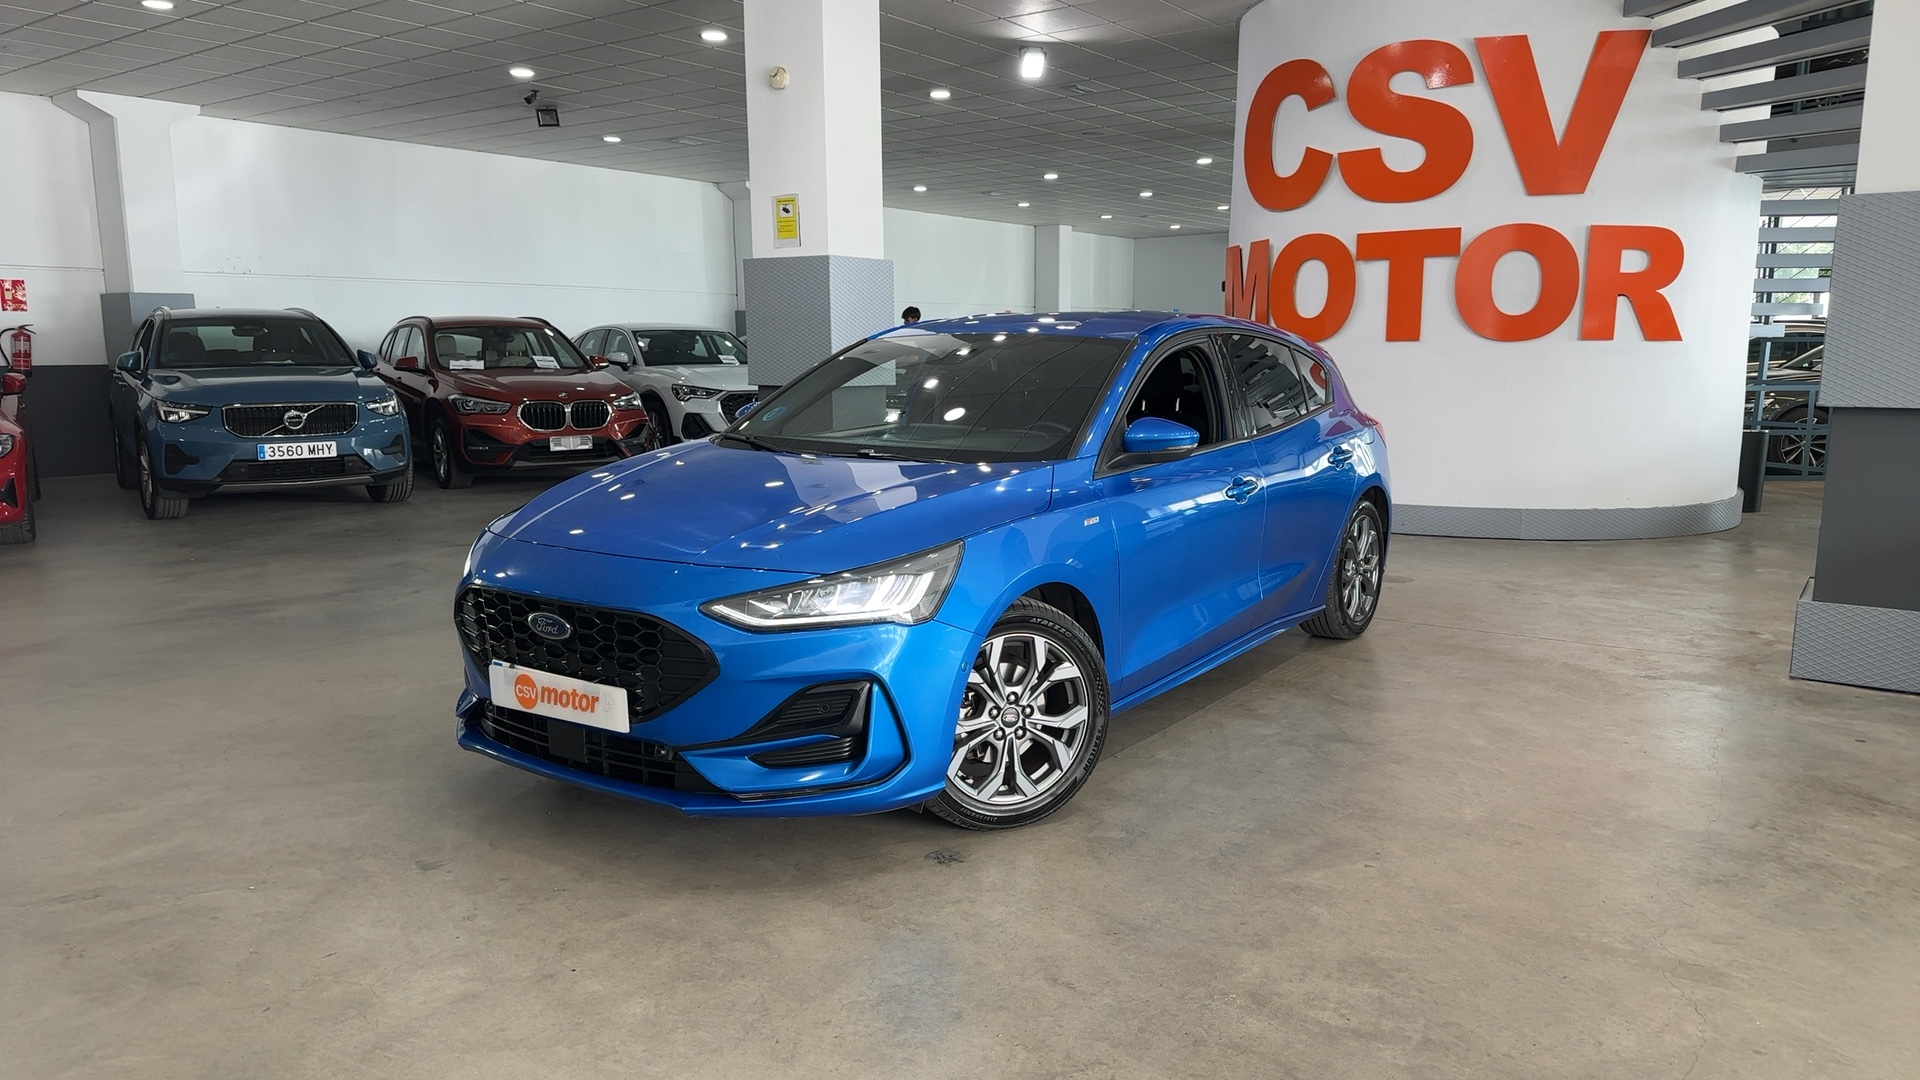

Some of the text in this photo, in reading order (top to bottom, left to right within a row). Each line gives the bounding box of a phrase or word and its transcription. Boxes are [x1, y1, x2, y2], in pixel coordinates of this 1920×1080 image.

[1244, 29, 1652, 211] CSV
[1225, 223, 1684, 342] MOTOR
[268, 444, 332, 457] 3560 MHY
[536, 617, 559, 635] Ford
[1029, 617, 1072, 638] ATREZZO
[515, 684, 537, 699] CSV
[541, 686, 599, 713] motor
